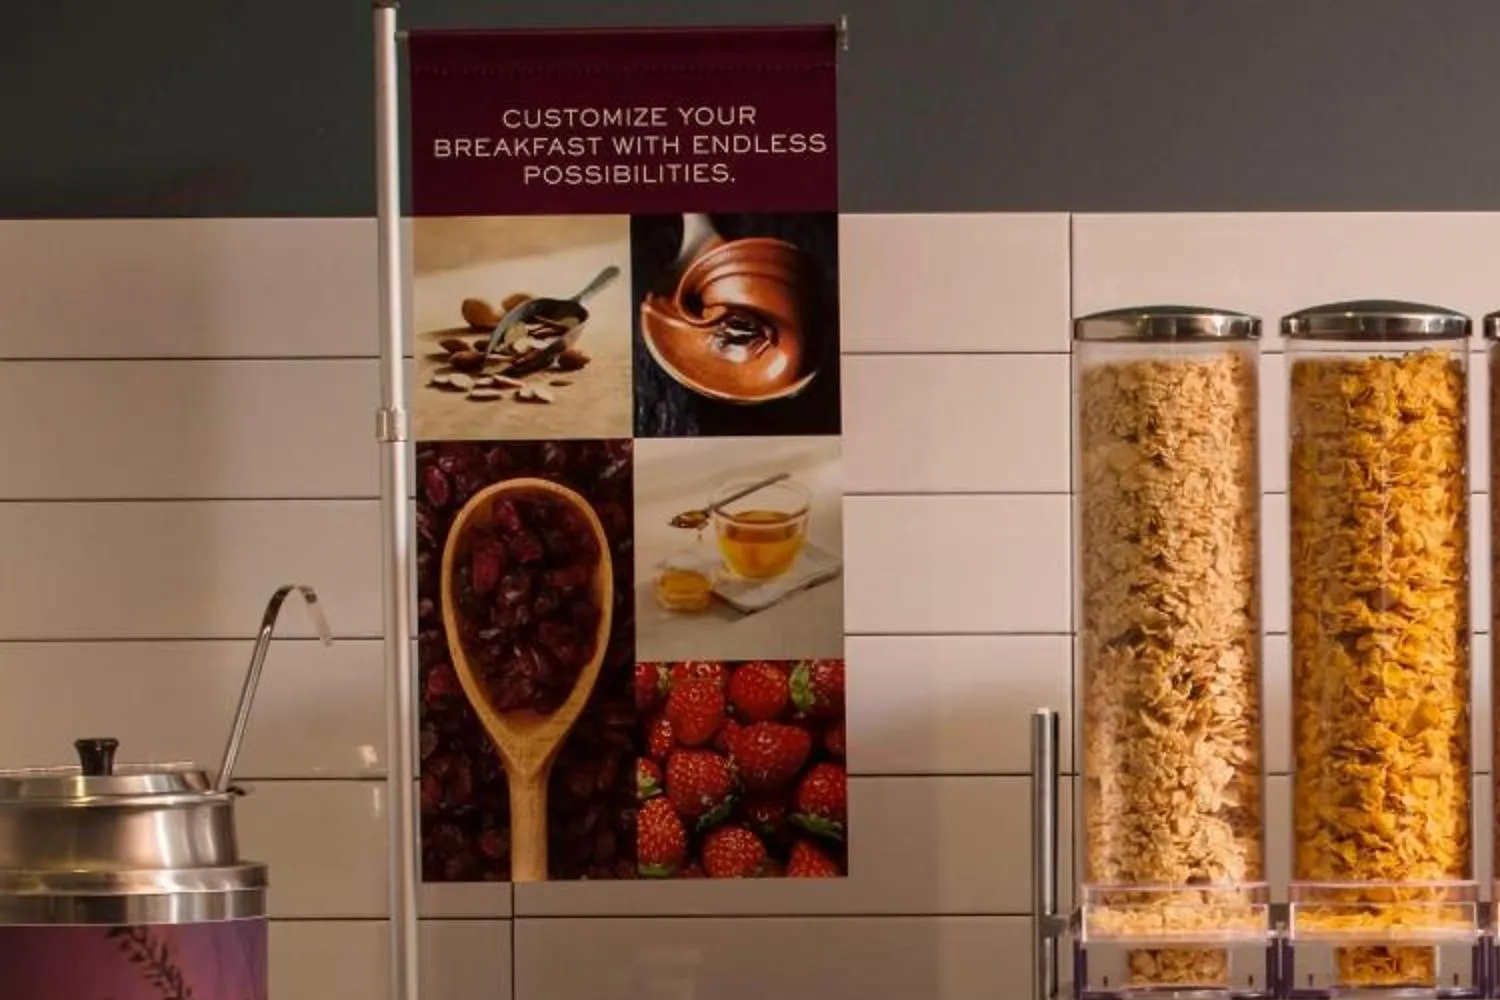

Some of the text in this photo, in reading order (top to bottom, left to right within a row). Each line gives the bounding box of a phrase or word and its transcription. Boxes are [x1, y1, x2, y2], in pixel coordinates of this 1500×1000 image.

[503, 106, 757, 128] CUSTOMIZE YOUR
[434, 133, 828, 158] BREAKFAST WITH ENDLESS
[523, 163, 736, 185] POSSIBILITIES.
